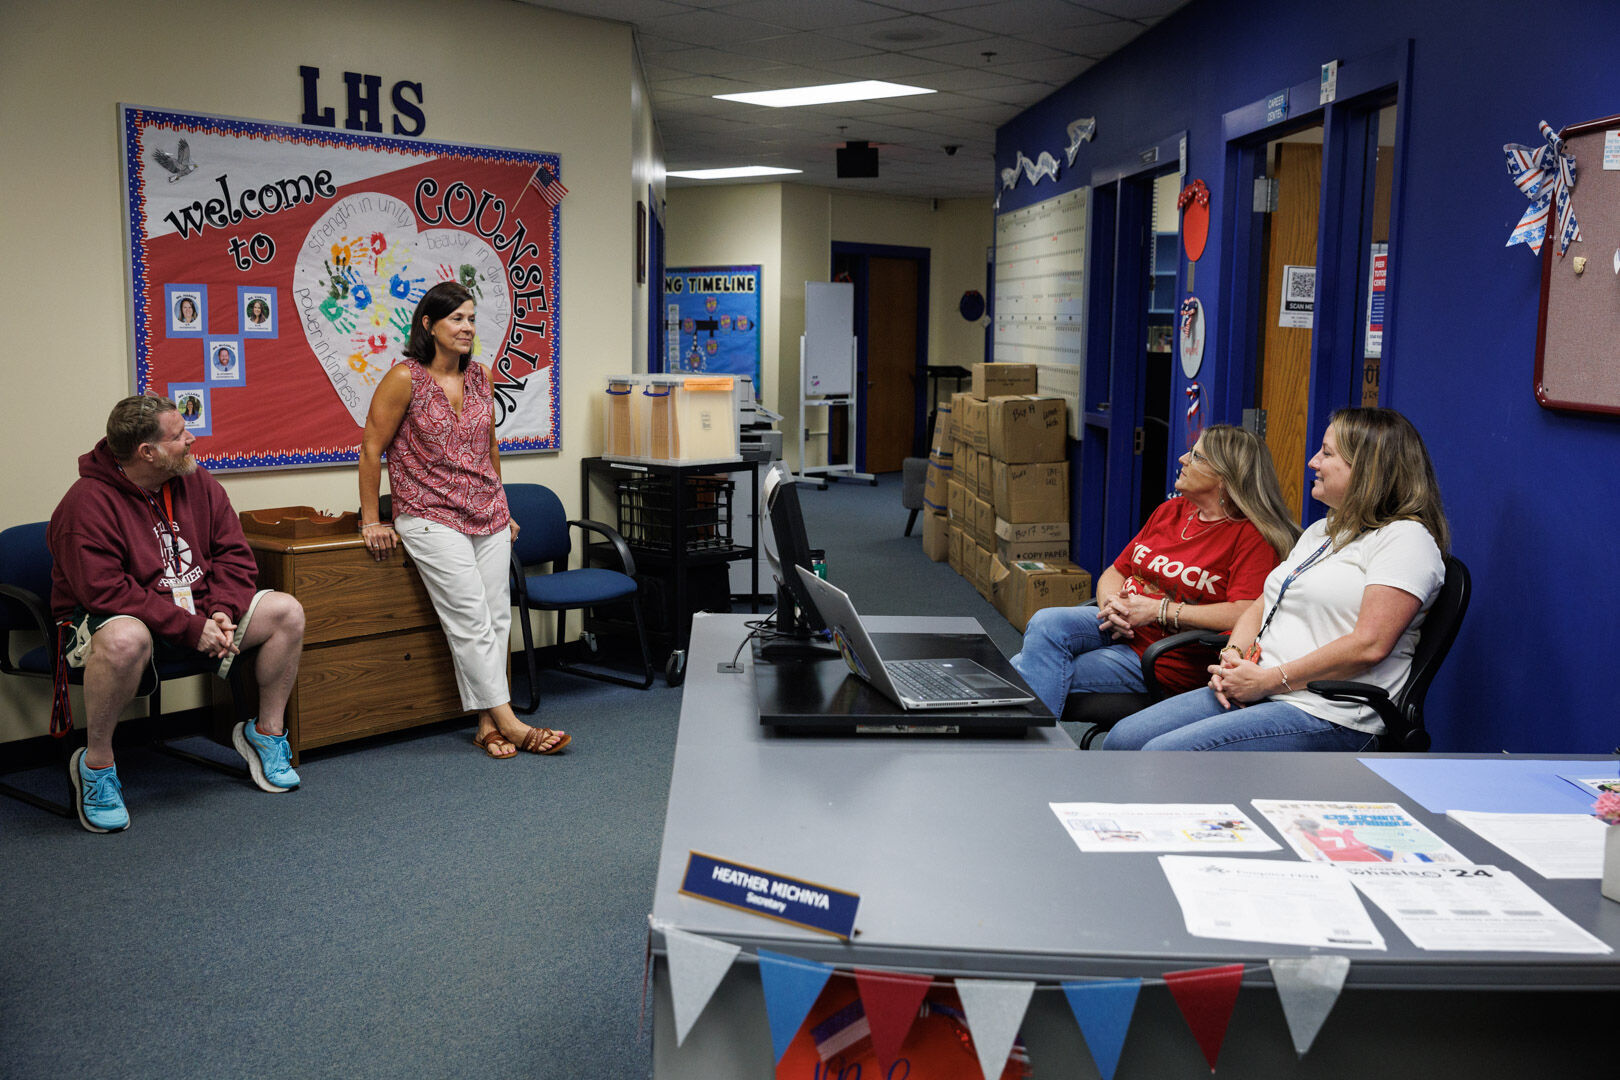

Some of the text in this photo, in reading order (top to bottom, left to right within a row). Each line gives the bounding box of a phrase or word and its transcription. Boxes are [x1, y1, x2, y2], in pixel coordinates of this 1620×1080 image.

[299, 65, 426, 137] LHS
[163, 169, 337, 239] welcome
[308, 196, 416, 252] strength in unity
[229, 233, 275, 269] to
[424, 232, 512, 331] beauty in diversity
[688, 277, 754, 292] TIMELINE
[294, 287, 362, 409] power in kindness
[1022, 549, 1068, 560] COPY PAPER
[1147, 554, 1223, 595] ROCK
[712, 866, 830, 911] HEATHER MICHNYA
[746, 893, 787, 913] Secretary
